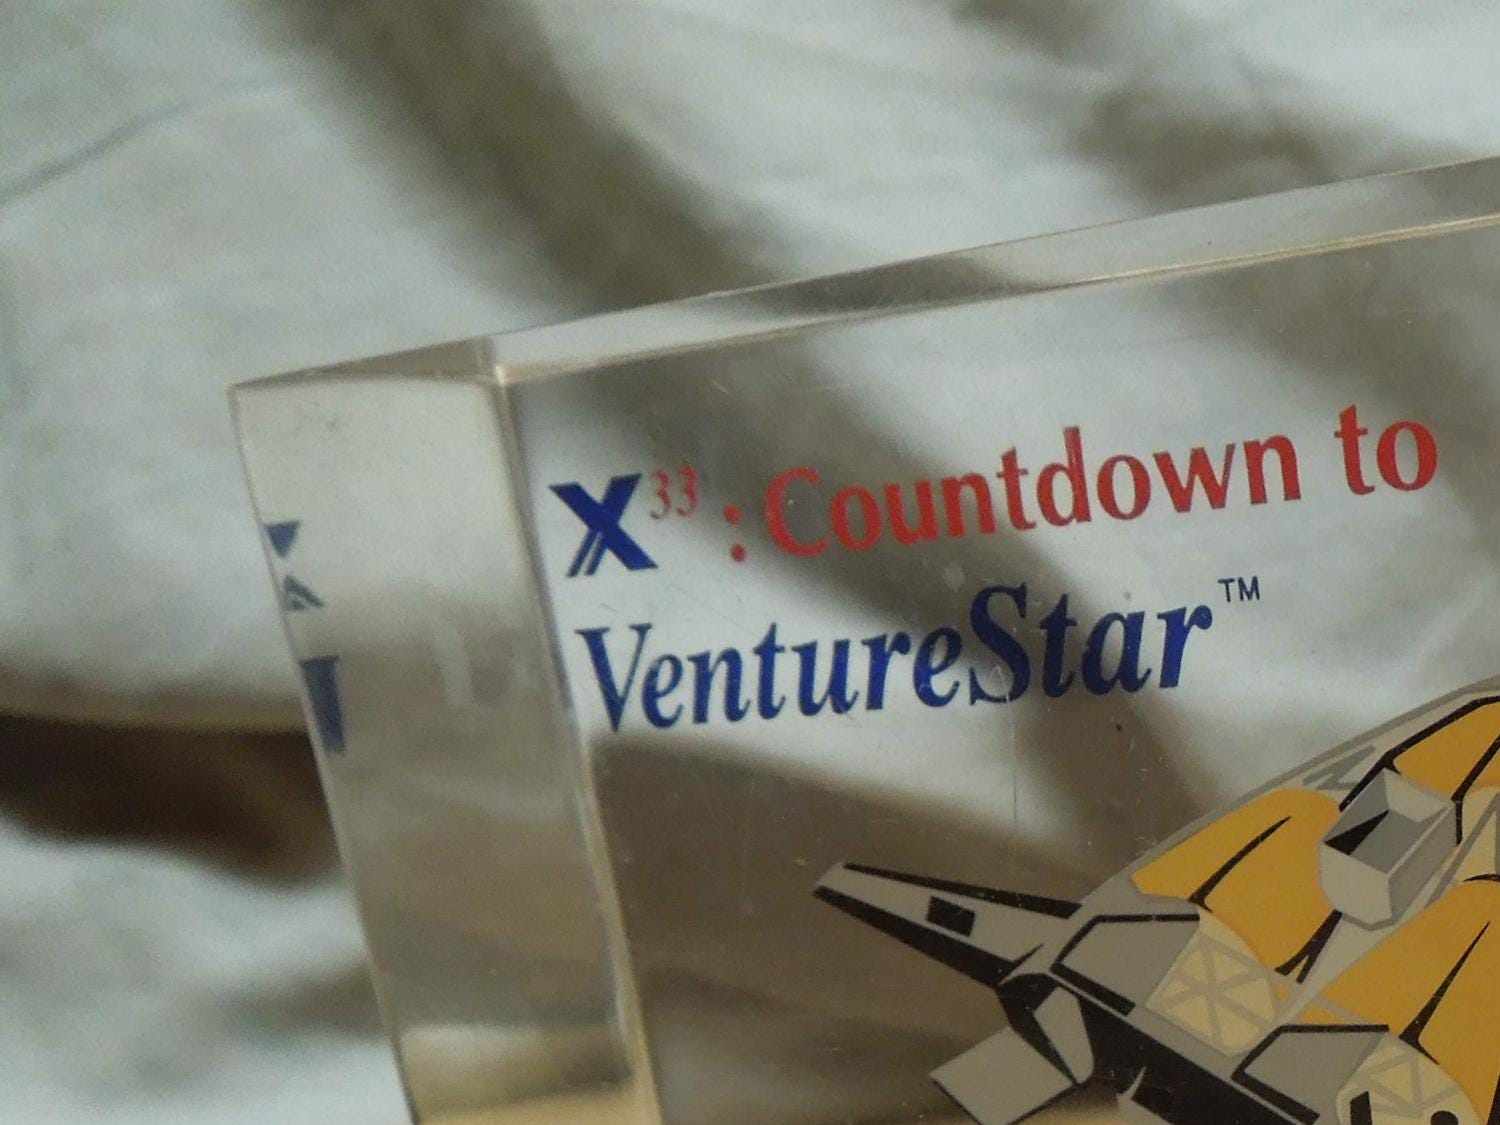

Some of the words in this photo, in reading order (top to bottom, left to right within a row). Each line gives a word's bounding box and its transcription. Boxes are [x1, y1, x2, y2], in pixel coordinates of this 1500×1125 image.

[764, 426, 1303, 558] Countdown
[1333, 405, 1439, 496] to
[574, 583, 1214, 734] VentureStar
